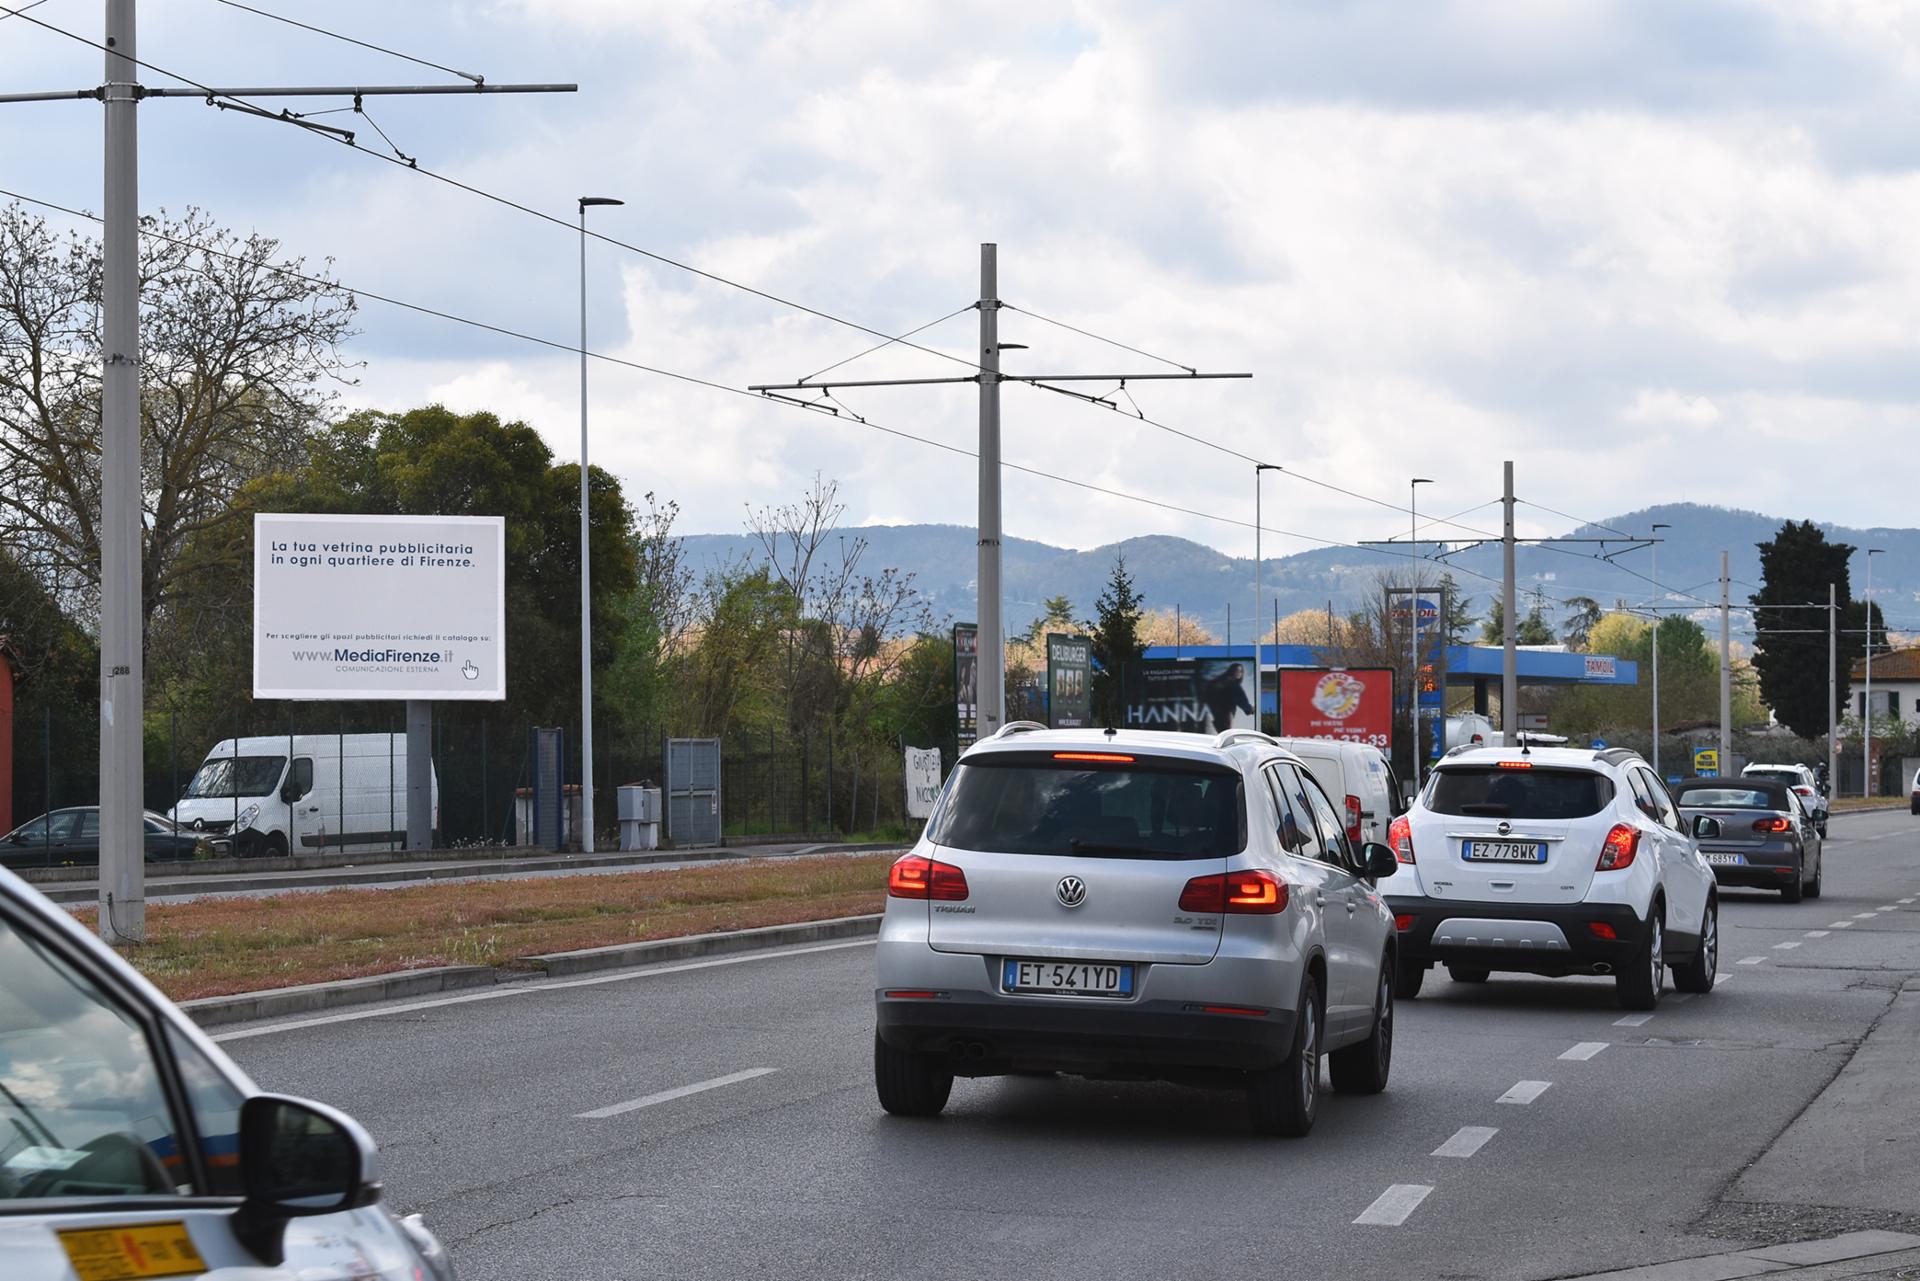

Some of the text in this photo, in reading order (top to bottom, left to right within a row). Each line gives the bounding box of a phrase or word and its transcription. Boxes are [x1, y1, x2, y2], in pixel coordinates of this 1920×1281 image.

[272, 541, 473, 555] La tua vetrina pubblicitaria
[271, 554, 476, 568] in ogni quartiere di Firenze.
[266, 632, 279, 640] Per
[281, 633, 318, 642] scegliere
[320, 633, 331, 642] gli
[333, 633, 353, 642] spazi
[355, 633, 401, 642] pubblicitari
[442, 634, 478, 643] catalogo
[292, 648, 454, 664] www.MediaFirenze.it
[1051, 644, 1087, 662] DELIBURGER
[335, 665, 404, 673] COMUNICAZIONE
[1127, 702, 1215, 723] HANNA
[1472, 842, 1537, 860] EZ 778WK
[1020, 963, 1045, 986] ET
[1052, 965, 1118, 990] 541YD
